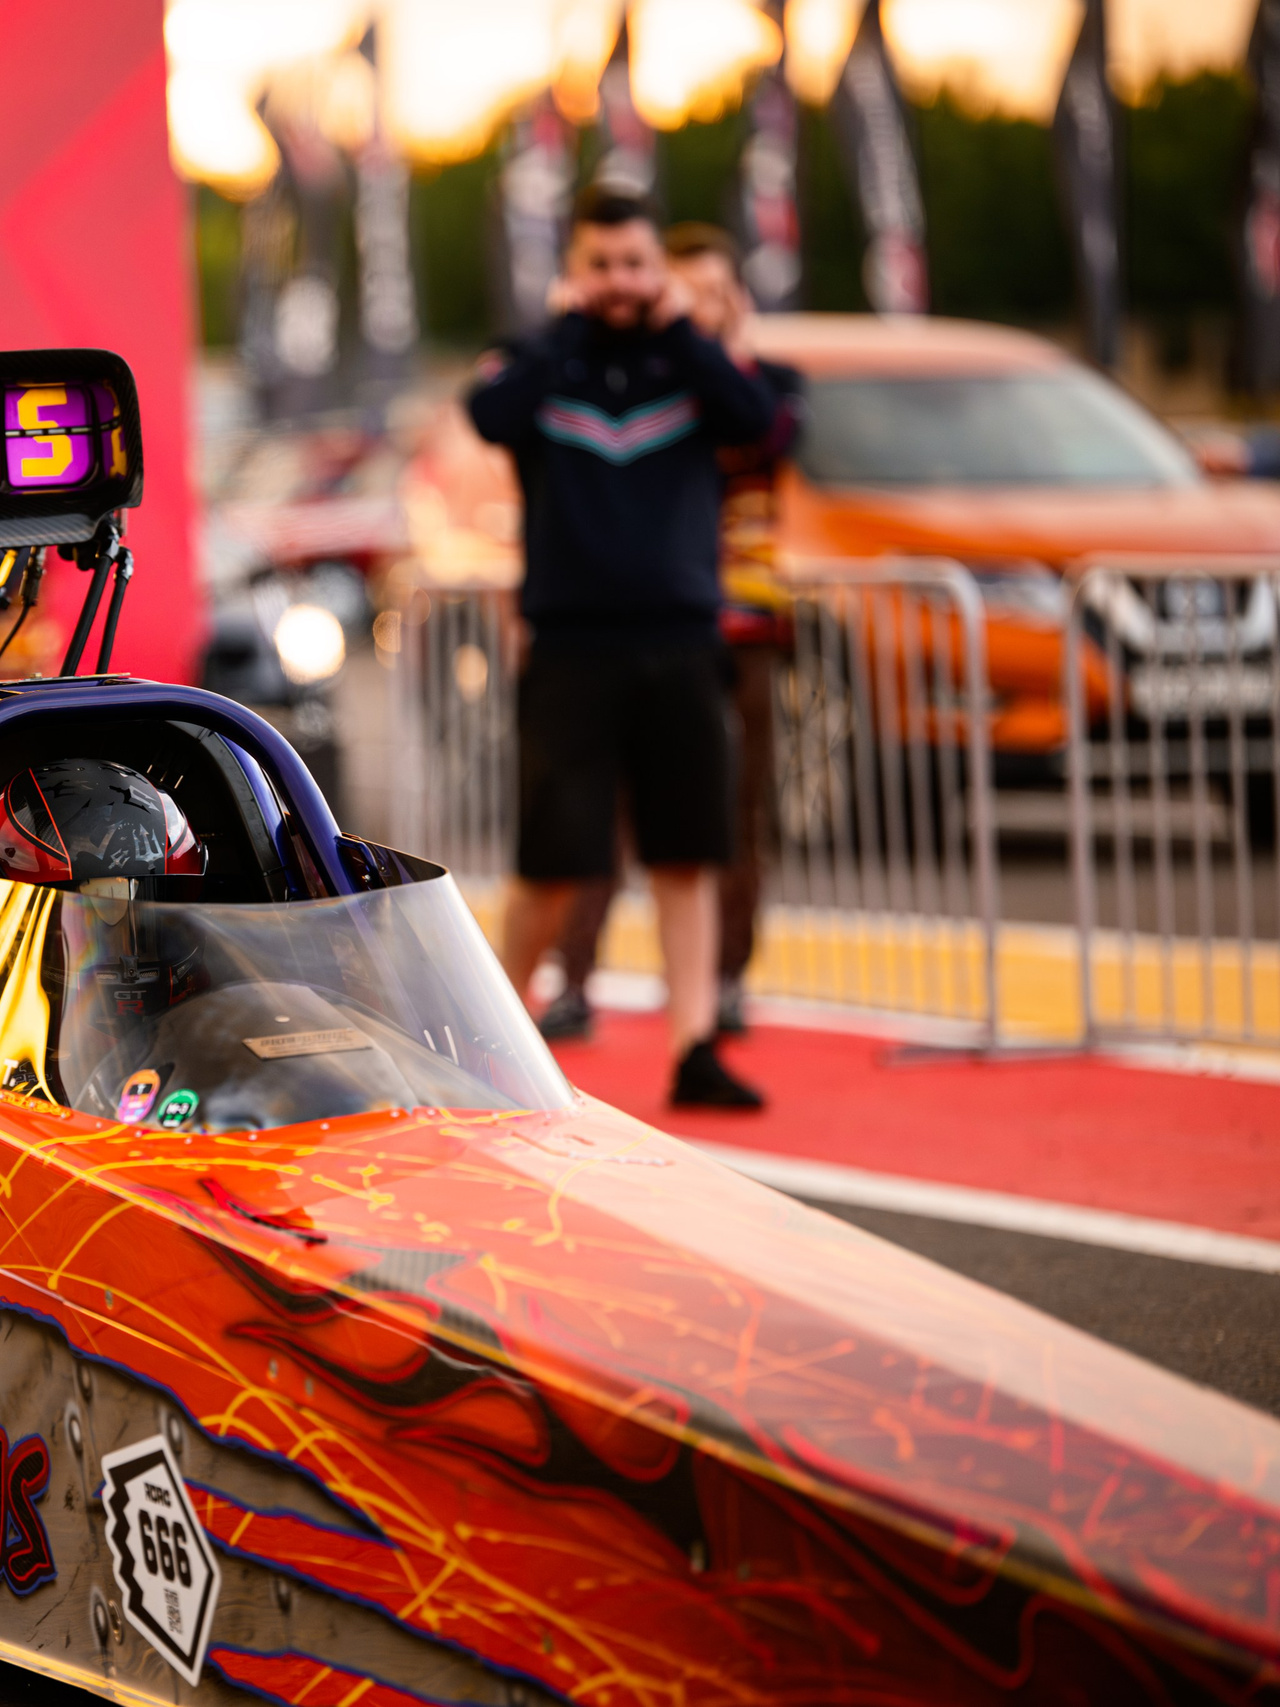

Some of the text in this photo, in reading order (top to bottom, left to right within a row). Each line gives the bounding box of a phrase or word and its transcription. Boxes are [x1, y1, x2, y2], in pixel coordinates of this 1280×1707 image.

[113, 990, 147, 1000] GT
[116, 1000, 144, 1016] R
[138, 1509, 192, 1588] 666
